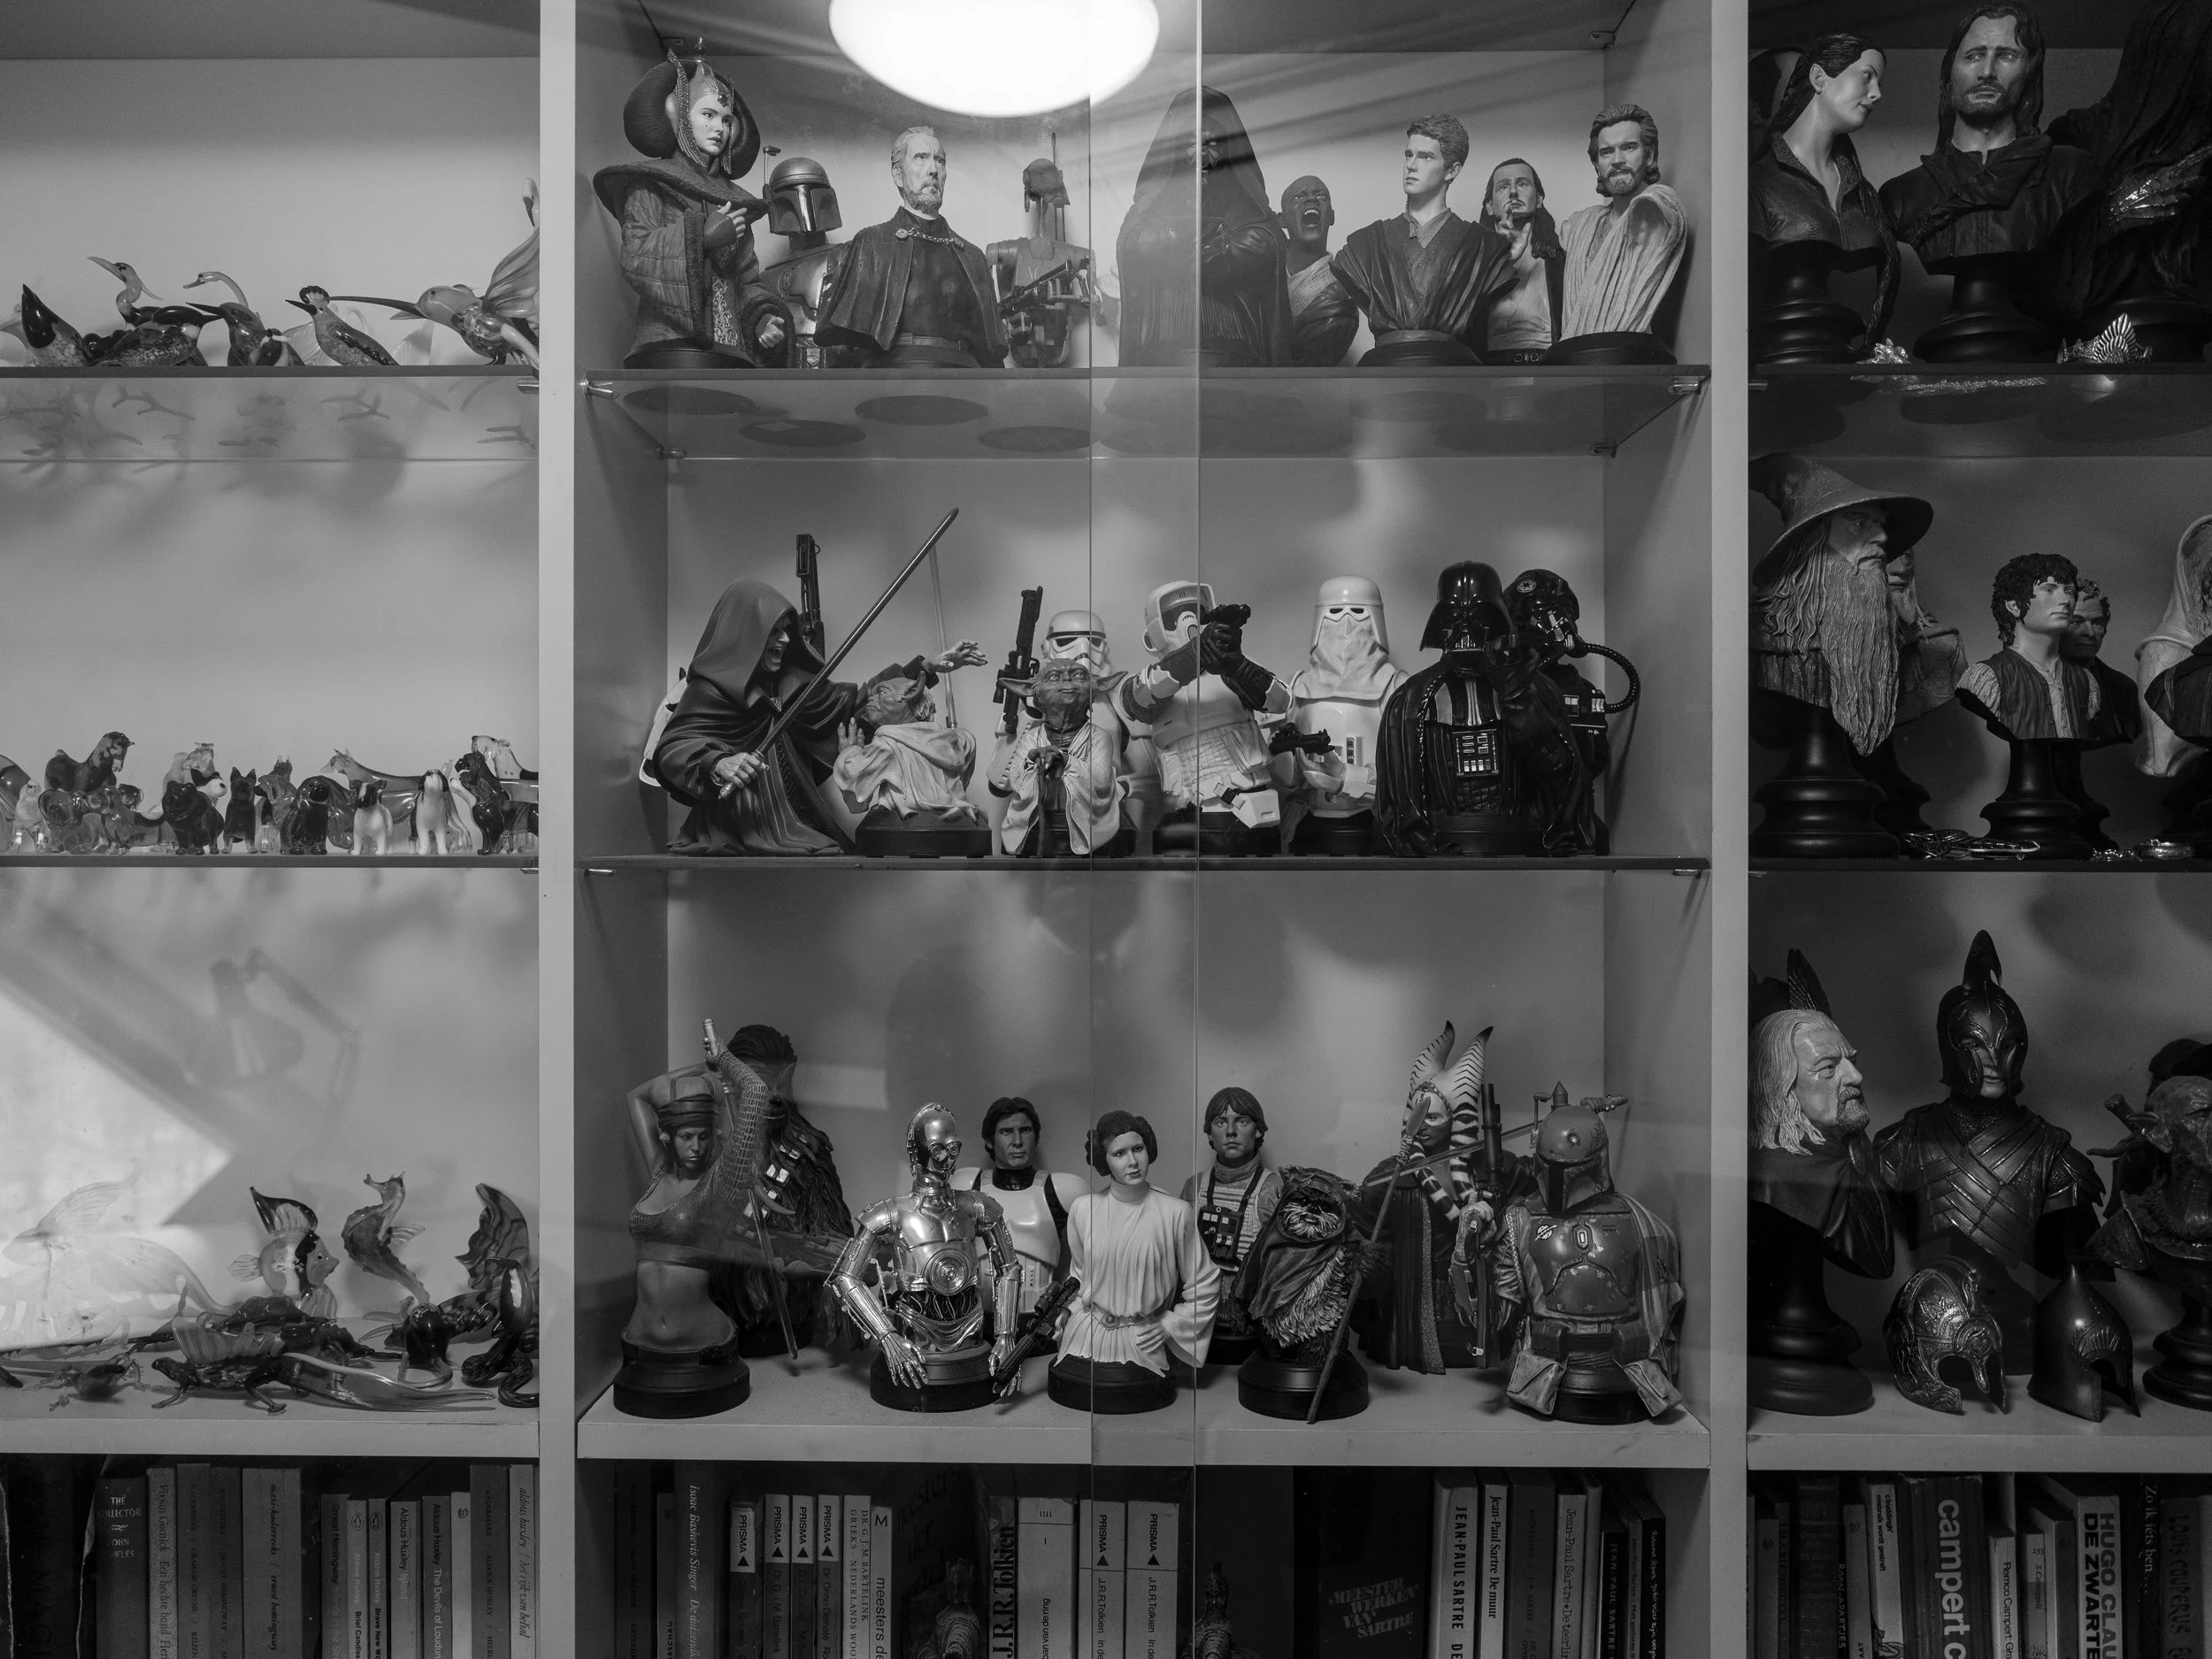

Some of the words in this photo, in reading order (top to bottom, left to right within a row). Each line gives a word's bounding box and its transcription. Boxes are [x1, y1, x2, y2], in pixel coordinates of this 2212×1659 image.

[111, 1495, 126, 1505] THE
[519, 1488, 530, 1516] aldous
[689, 1485, 700, 1511] Isaac
[2145, 1486, 2156, 1502] Zo
[98, 1509, 142, 1517] COLLECTOR
[433, 1503, 442, 1533] Aldous
[1490, 1495, 1502, 1542] Jean-Paul
[2145, 1508, 2157, 1519] ik
[518, 1517, 530, 1548] huxley
[689, 1514, 700, 1555] Bashevis
[1453, 1506, 1467, 1577] JEAN-PAUL
[1564, 1509, 1577, 1563] Jean-Paul
[2084, 1513, 2099, 1548] DE
[2145, 1524, 2157, 1545] iets
[331, 1534, 340, 1583] Hemingway
[399, 1540, 409, 1571] Huxley
[432, 1536, 442, 1565] Huxley
[1489, 1544, 1501, 1574] Sartre
[1878, 1546, 1886, 1571] gestraft
[2101, 1513, 2116, 1586] HUGO
[2145, 1548, 2157, 1572] ben
[159, 1561, 169, 1578] Een
[519, 1561, 529, 1574] het
[687, 1558, 700, 1590] Singer
[1934, 1500, 1970, 1636] campert
[159, 1581, 170, 1609] hechte
[400, 1573, 409, 1600] Island
[518, 1576, 530, 1592] rijk
[1489, 1577, 1500, 1590] De
[1563, 1565, 1574, 1602] Sartre
[434, 1587, 442, 1613] Devils
[689, 1599, 700, 1614] De
[875, 1578, 886, 1640] meesters
[1041, 1598, 1050, 1615] ring
[1148, 1577, 1156, 1632] J.R.R.Tolkien
[1452, 1581, 1464, 1630] SARTRE
[1488, 1592, 1497, 1619] muur
[2085, 1553, 2101, 1659] ZWARTE
[160, 1612, 171, 1635] band
[268, 1602, 280, 1651] hemingway
[434, 1615, 442, 1624] of
[518, 1613, 530, 1639] belial
[1041, 1616, 1049, 1626] de
[1563, 1609, 1572, 1623] De
[1608, 1609, 1617, 1650] SARTRE
[2003, 1598, 2013, 1640] Campert:
[1451, 1644, 1463, 1659] DE
